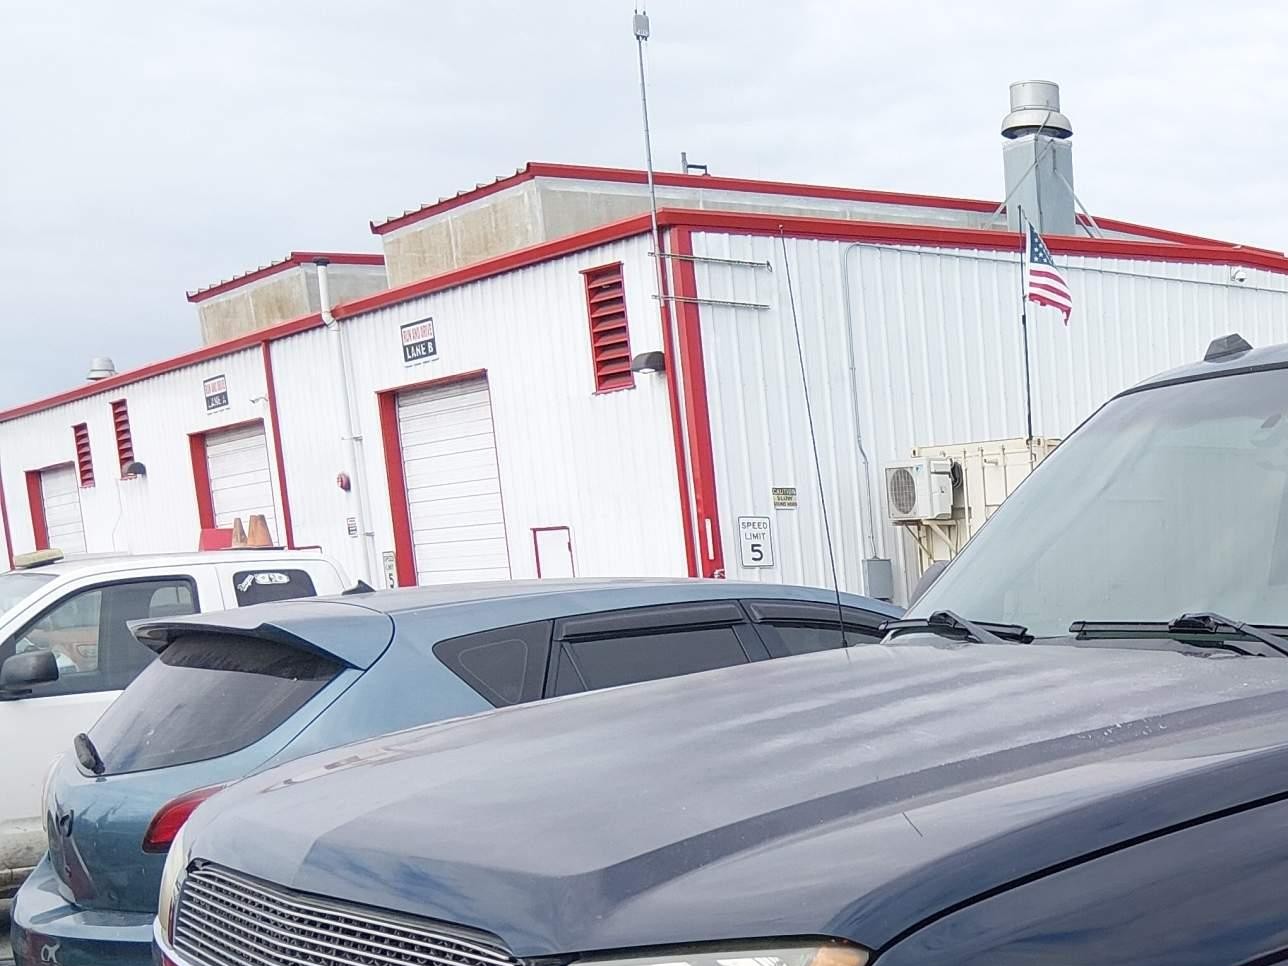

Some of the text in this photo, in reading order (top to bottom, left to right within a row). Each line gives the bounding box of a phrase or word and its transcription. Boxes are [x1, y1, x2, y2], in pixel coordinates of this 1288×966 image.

[405, 341, 434, 360] LANE B
[741, 522, 768, 530] SPEED
[744, 532, 766, 541] LIMIT
[750, 544, 763, 562] 5
